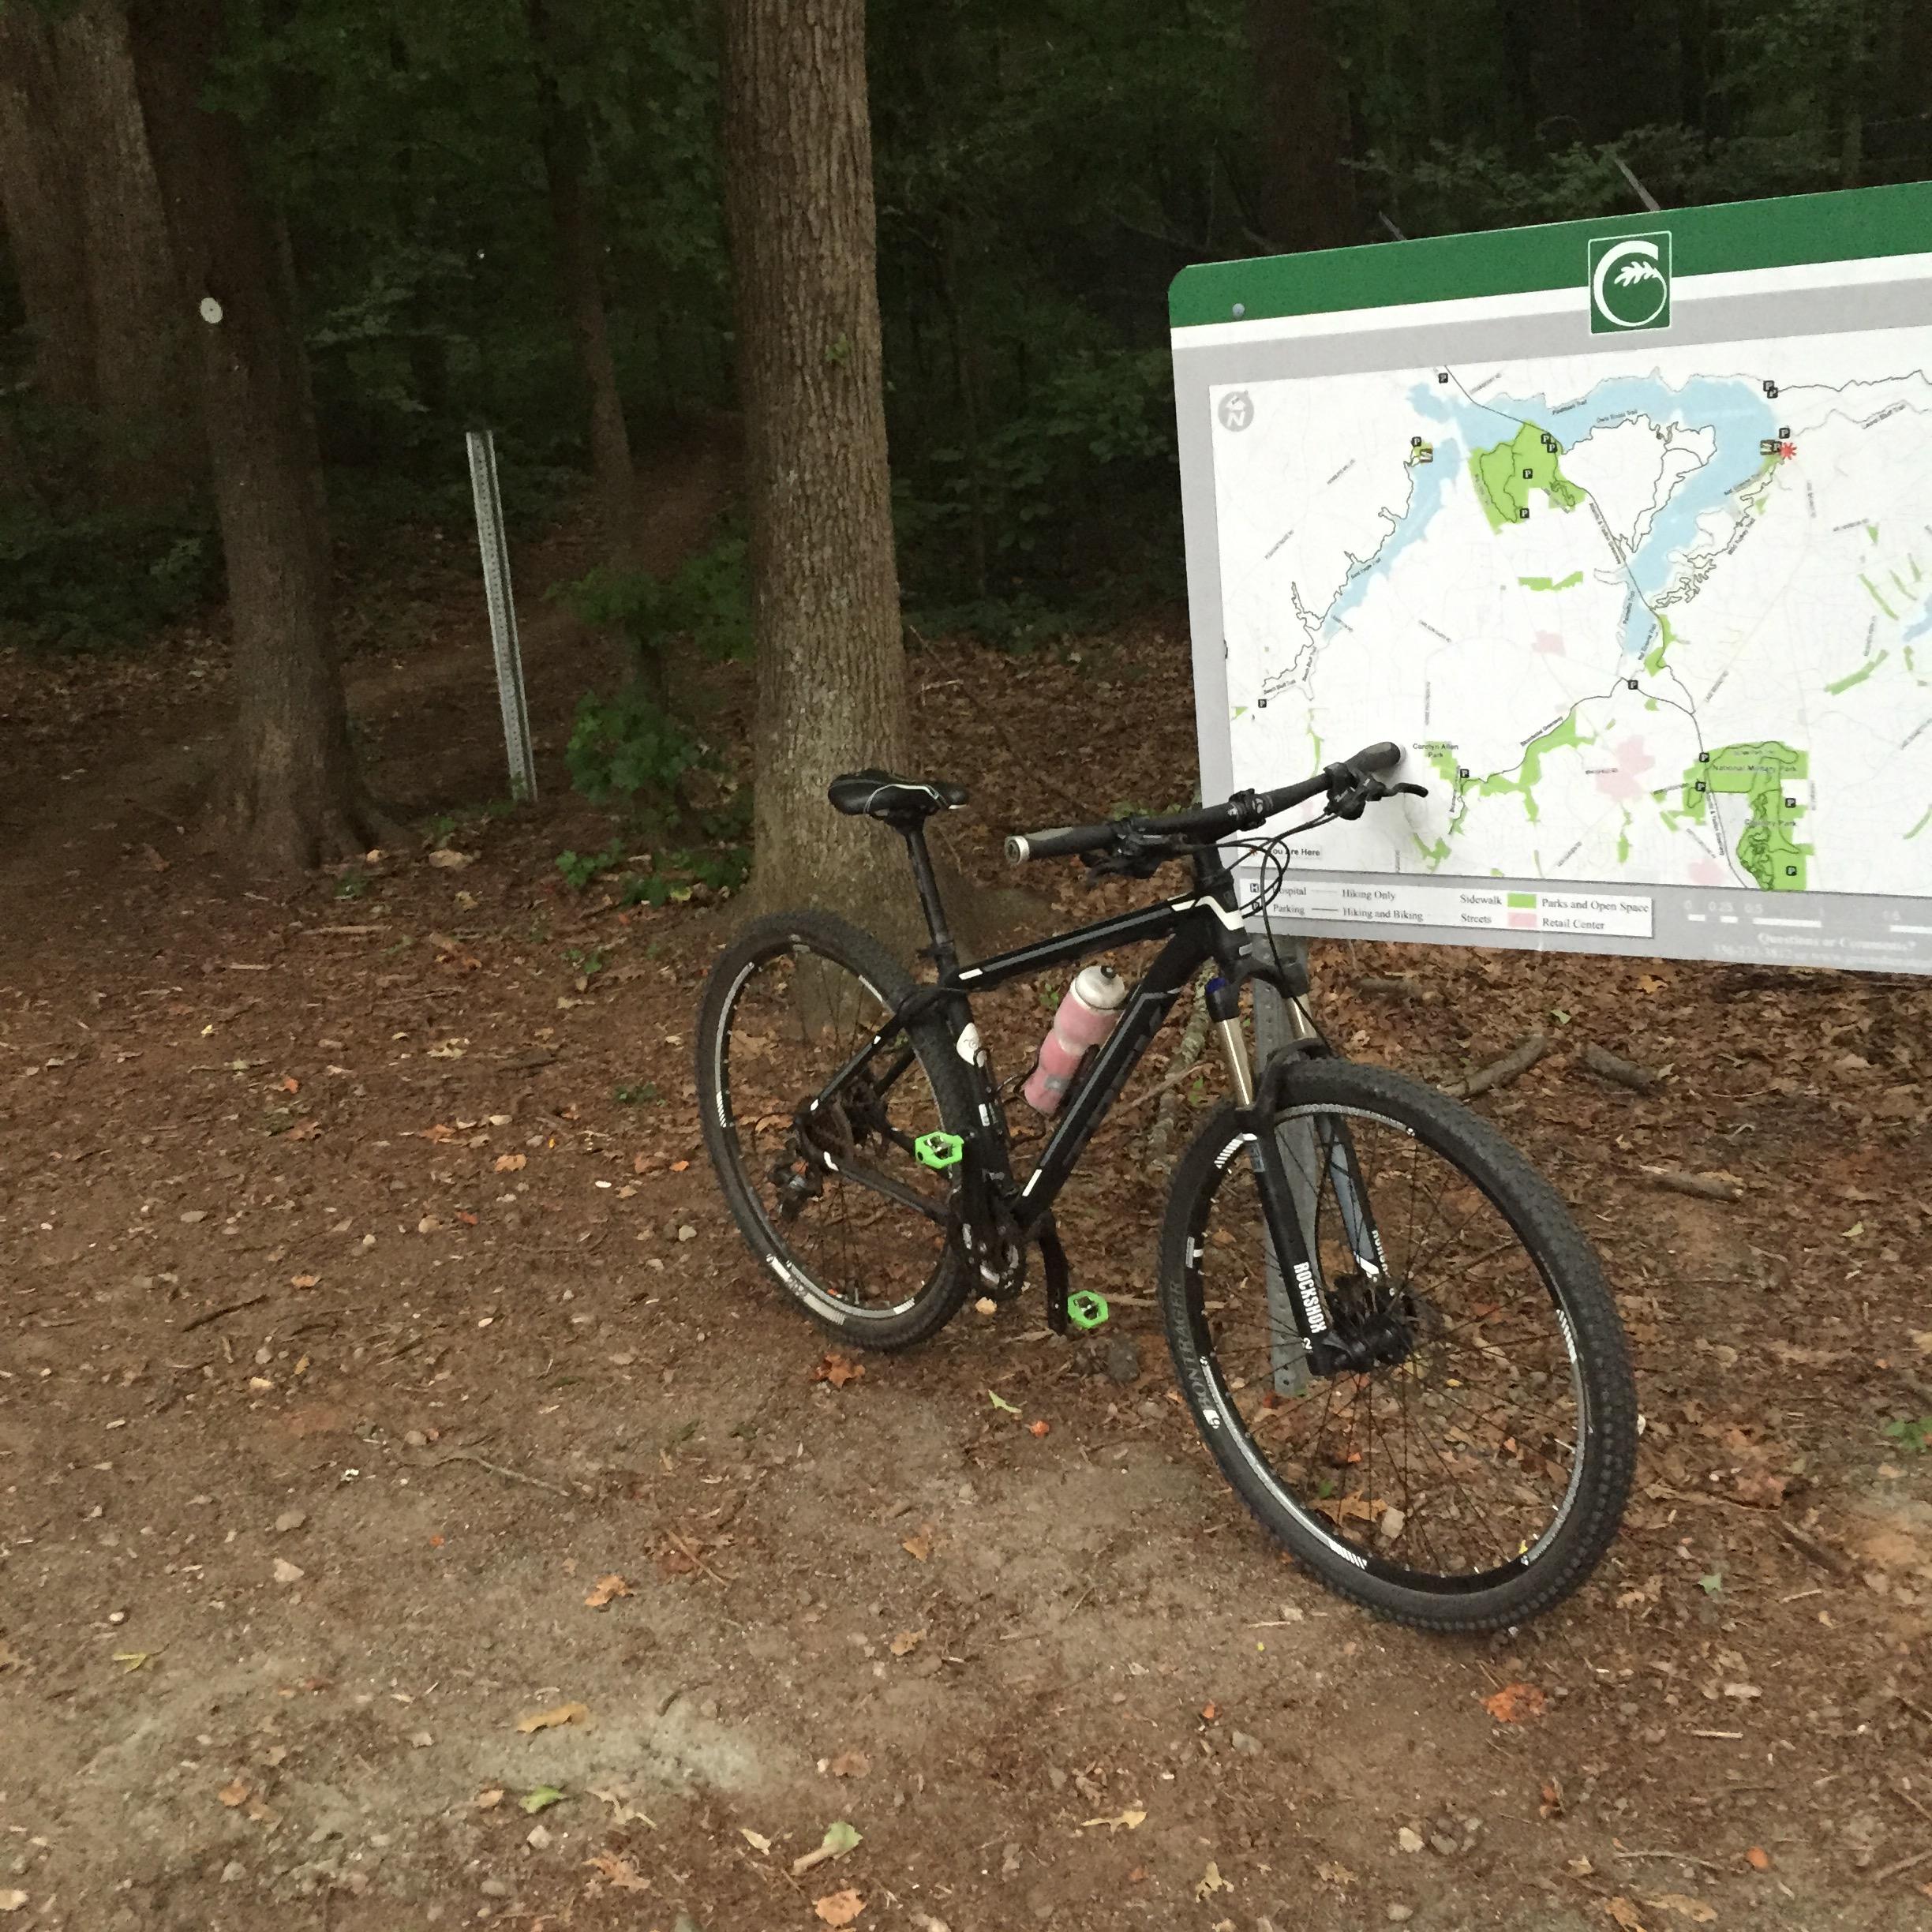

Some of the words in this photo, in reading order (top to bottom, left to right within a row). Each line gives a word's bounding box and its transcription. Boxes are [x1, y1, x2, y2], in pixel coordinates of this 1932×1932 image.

[1342, 889, 1372, 900] Hiking
[1375, 889, 1395, 900] Only
[1460, 893, 1502, 905] Sidewalk
[1273, 904, 1305, 915] Parking
[1542, 898, 1568, 908] Parks
[1571, 900, 1588, 909] and
[1591, 900, 1616, 912] Open
[1620, 902, 1649, 913] Space
[1343, 907, 1373, 919] Hiking
[1375, 909, 1391, 919] and
[1394, 910, 1424, 922] Biking
[1461, 913, 1492, 924] Streets
[1543, 918, 1570, 928] Retail
[1573, 919, 1605, 930] Center
[1294, 1261, 1327, 1334] ROCKSHOX
